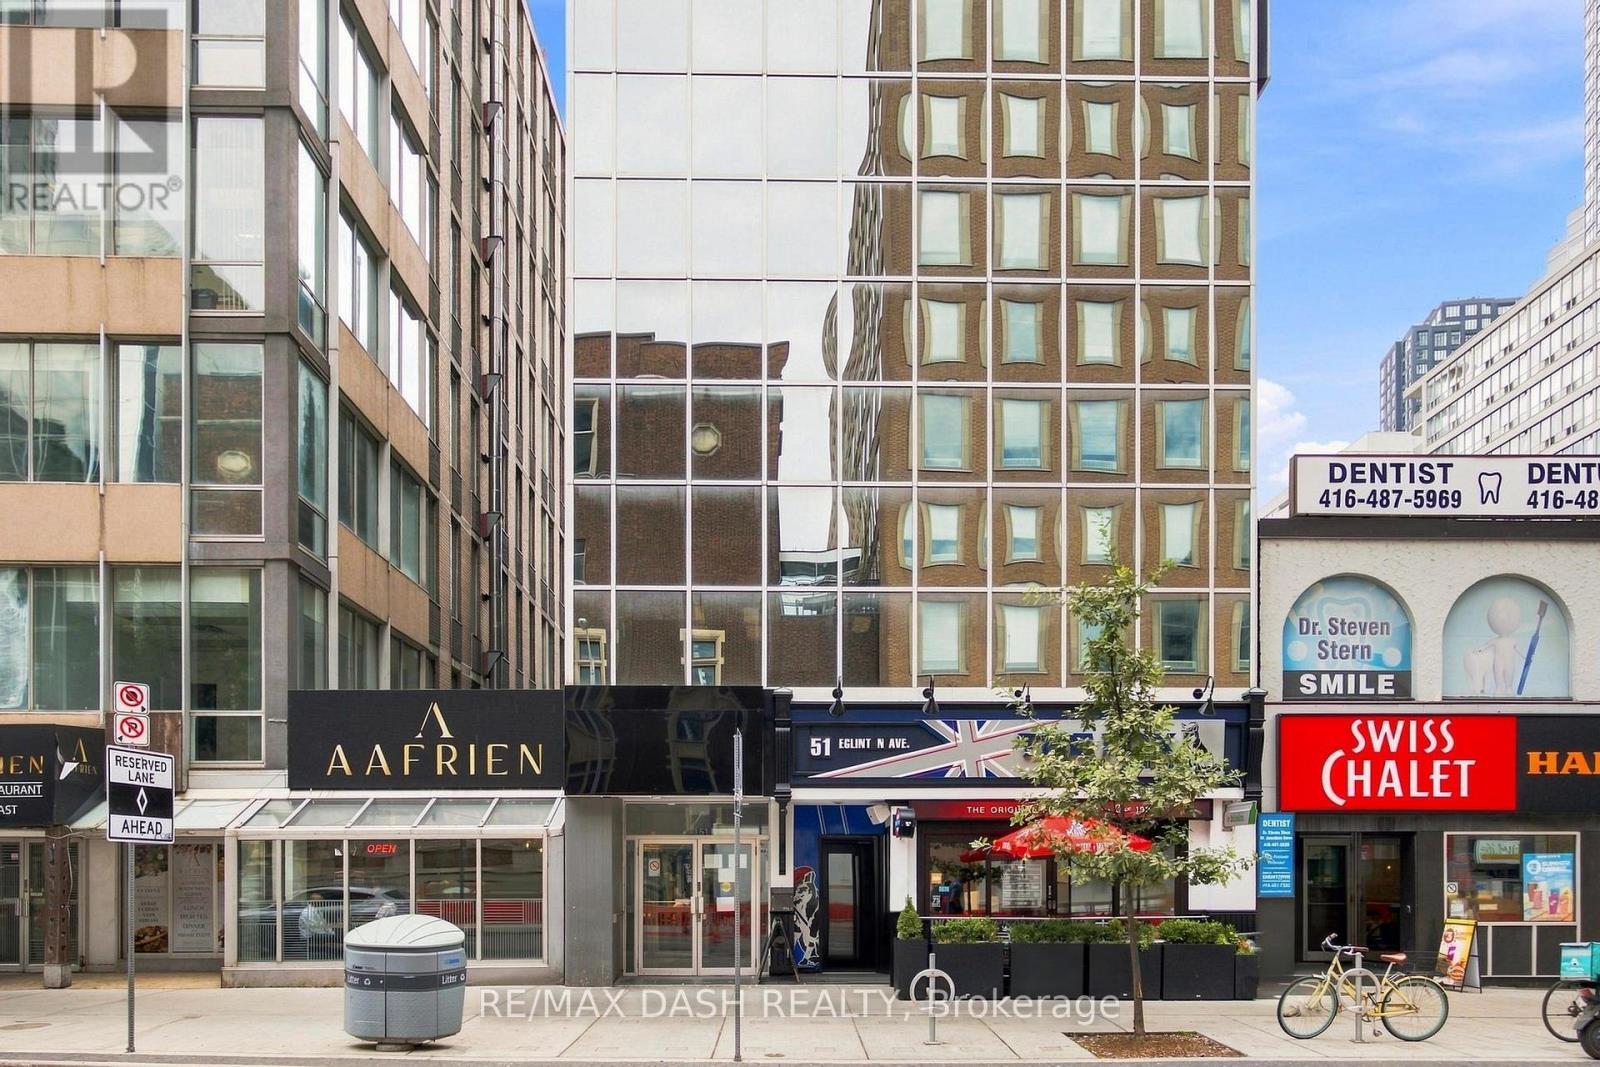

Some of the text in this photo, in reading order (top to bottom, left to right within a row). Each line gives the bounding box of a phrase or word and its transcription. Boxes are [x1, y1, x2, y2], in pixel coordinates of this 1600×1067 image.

[1329, 463, 1453, 484] DENTIST
[1528, 463, 1600, 484] DENT
[1319, 489, 1462, 509] 416-487-5969
[1527, 490, 1599, 509] 416-48
[1299, 617, 1390, 636] Dr. Steven
[1317, 639, 1372, 660] Stern
[1300, 673, 1395, 695] SMILE
[1350, 719, 1455, 753] SWISS
[810, 738, 831, 756] 51
[888, 738, 910, 749] AVE.
[115, 755, 167, 773] RESERVED
[326, 744, 543, 776] AAFRIEN
[128, 770, 155, 784] LANE
[1321, 749, 1477, 806] CHALET
[967, 806, 985, 814] THE
[121, 819, 163, 836] AHEAD
[1263, 820, 1290, 828] DENTIST
[367, 844, 397, 853] OPEN
[441, 974, 458, 985] Litter
